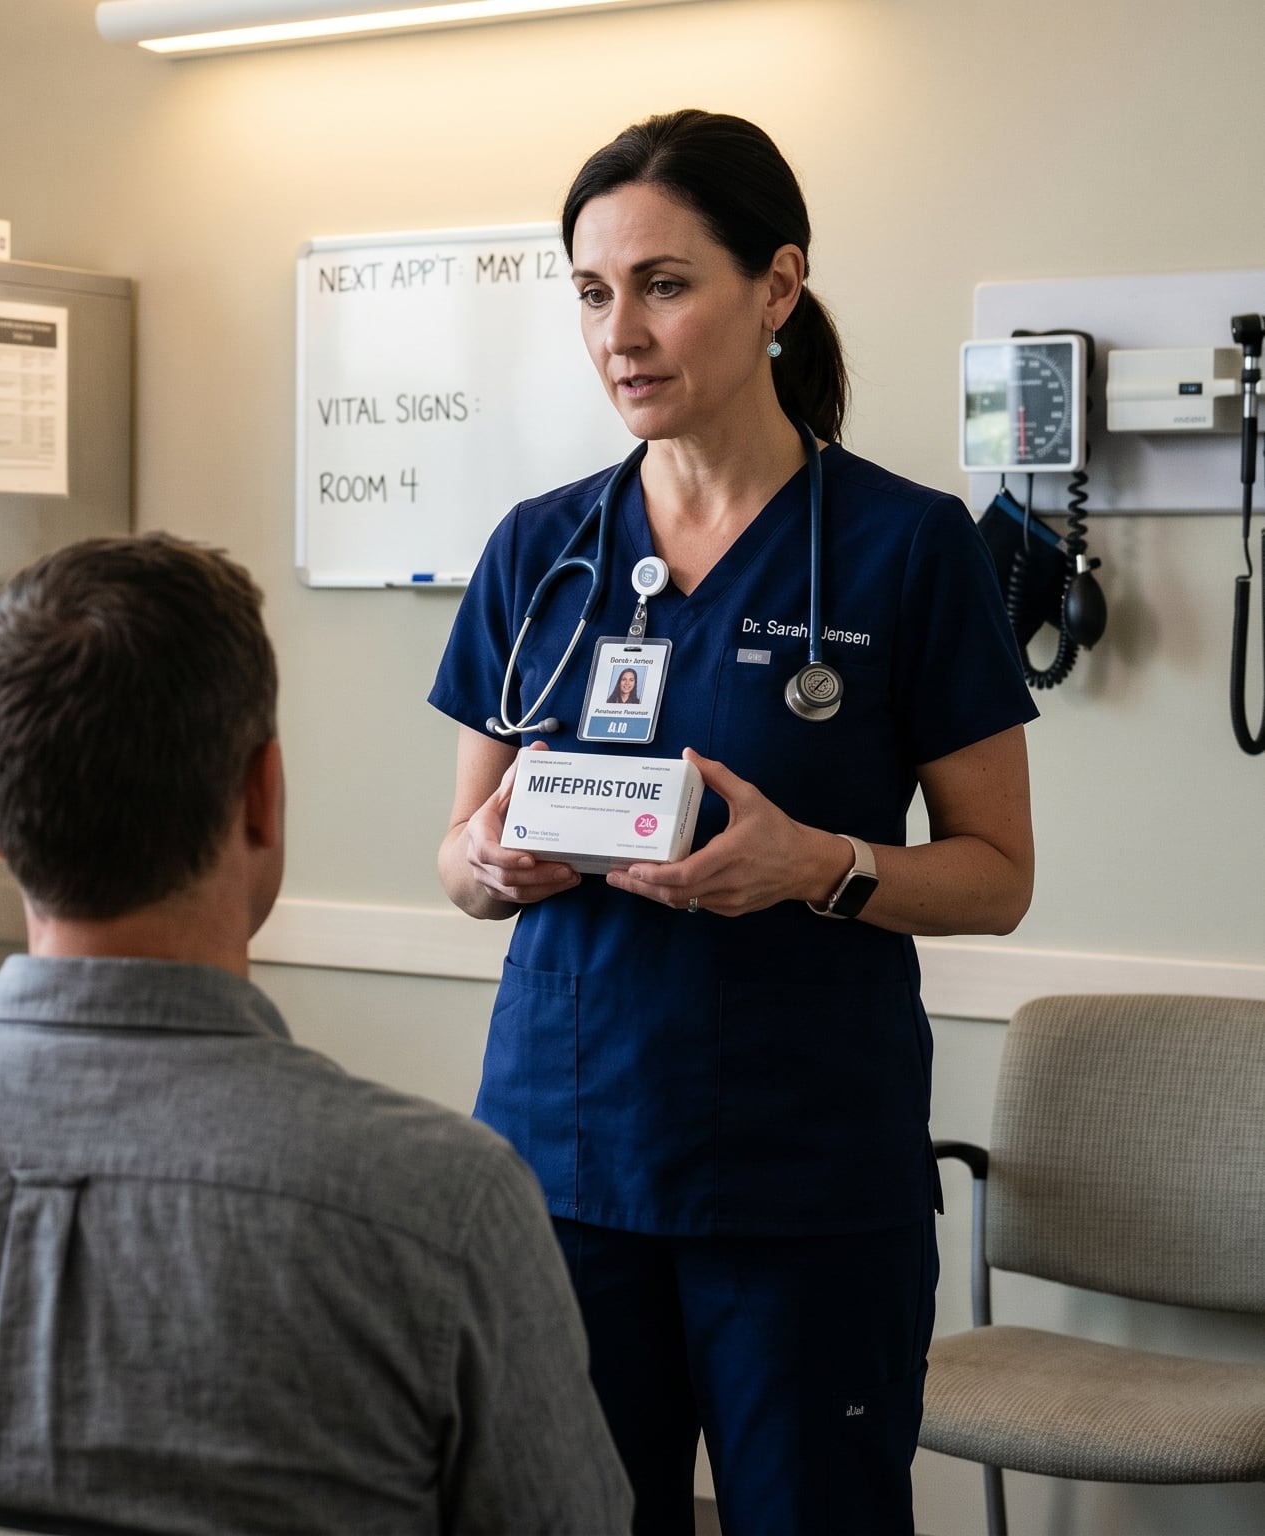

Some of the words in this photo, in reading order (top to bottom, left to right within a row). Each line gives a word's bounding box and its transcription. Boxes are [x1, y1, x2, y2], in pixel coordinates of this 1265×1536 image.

[319, 261, 383, 293] NEXT
[475, 252, 525, 284] MAY
[536, 251, 559, 279] 12
[317, 396, 387, 427] VITAL
[319, 471, 388, 504] ROOM
[399, 467, 419, 504] 4
[742, 617, 761, 634] Dr.
[766, 619, 809, 638] Sarah
[820, 625, 871, 647] Jensen
[527, 775, 663, 801] MIFEPRISTONE
